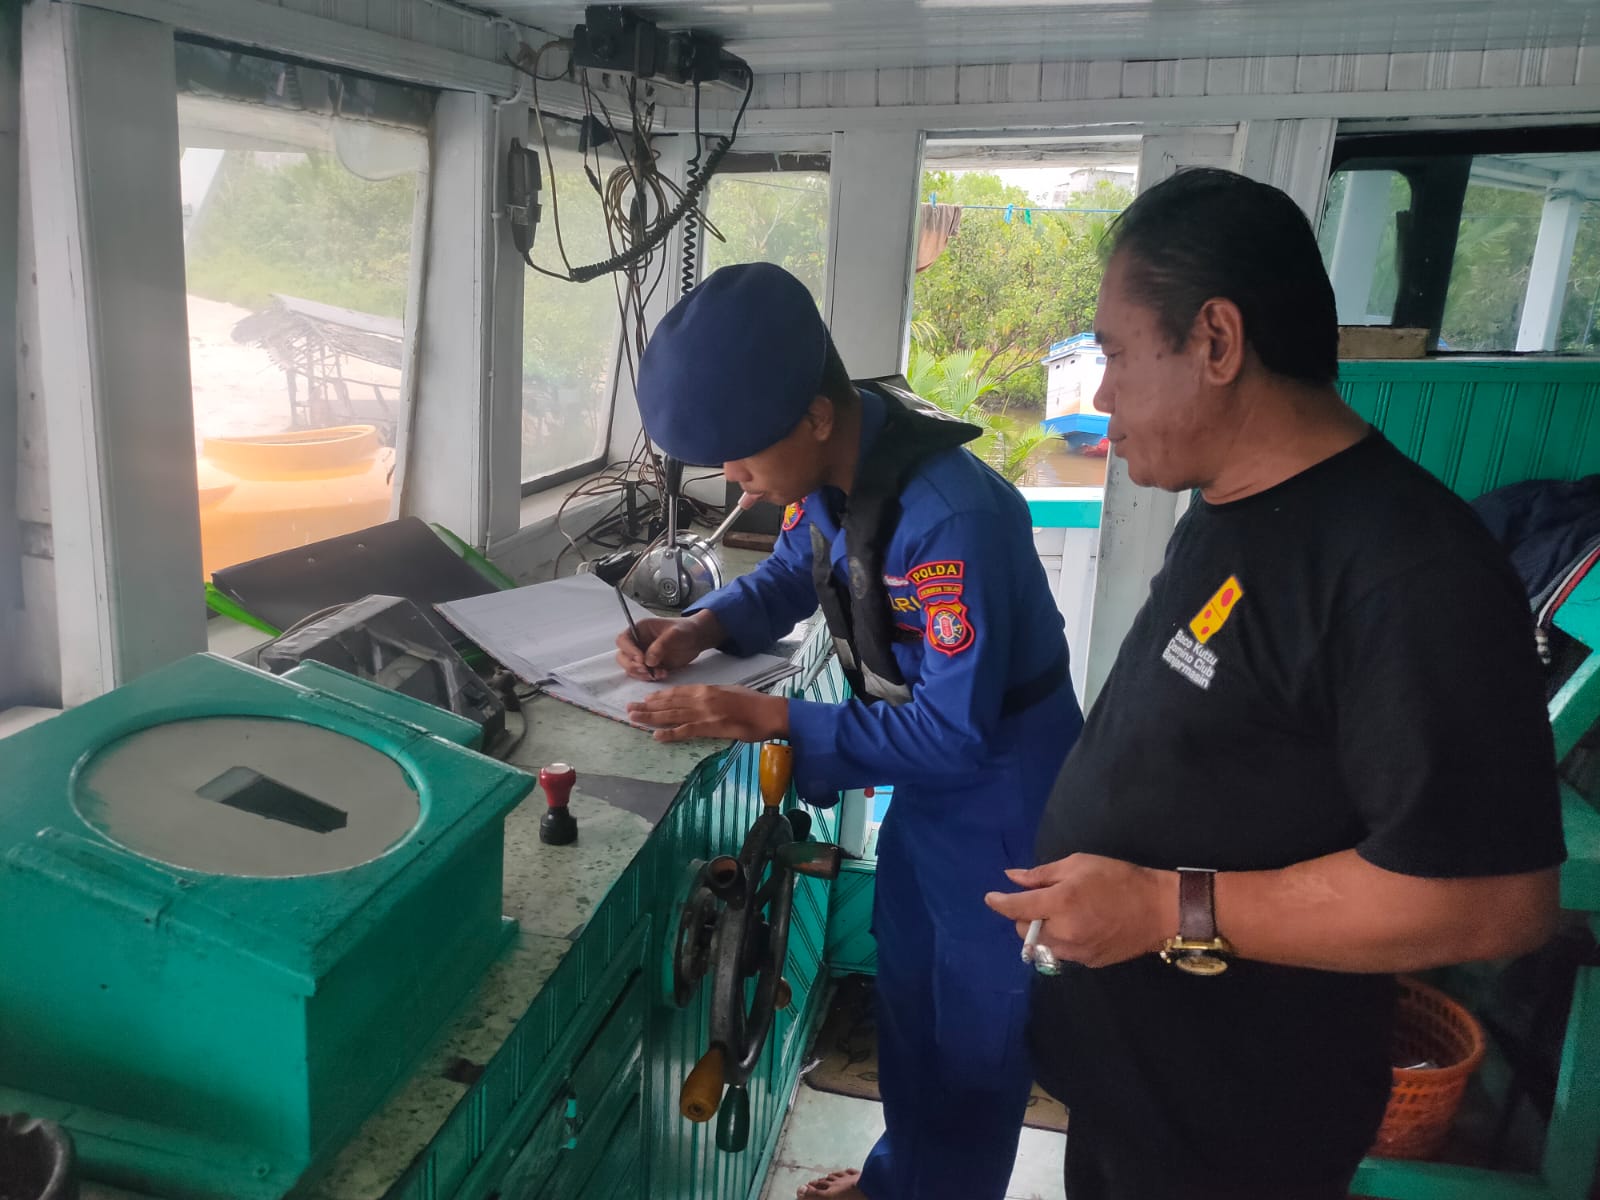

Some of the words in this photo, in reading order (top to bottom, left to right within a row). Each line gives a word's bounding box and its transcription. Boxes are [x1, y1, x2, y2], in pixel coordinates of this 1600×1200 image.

[912, 564, 957, 582] POLDA
[1161, 648, 1209, 689] Banjarmasin
[1167, 638, 1193, 664] Domino
[1194, 658, 1215, 678] Club
